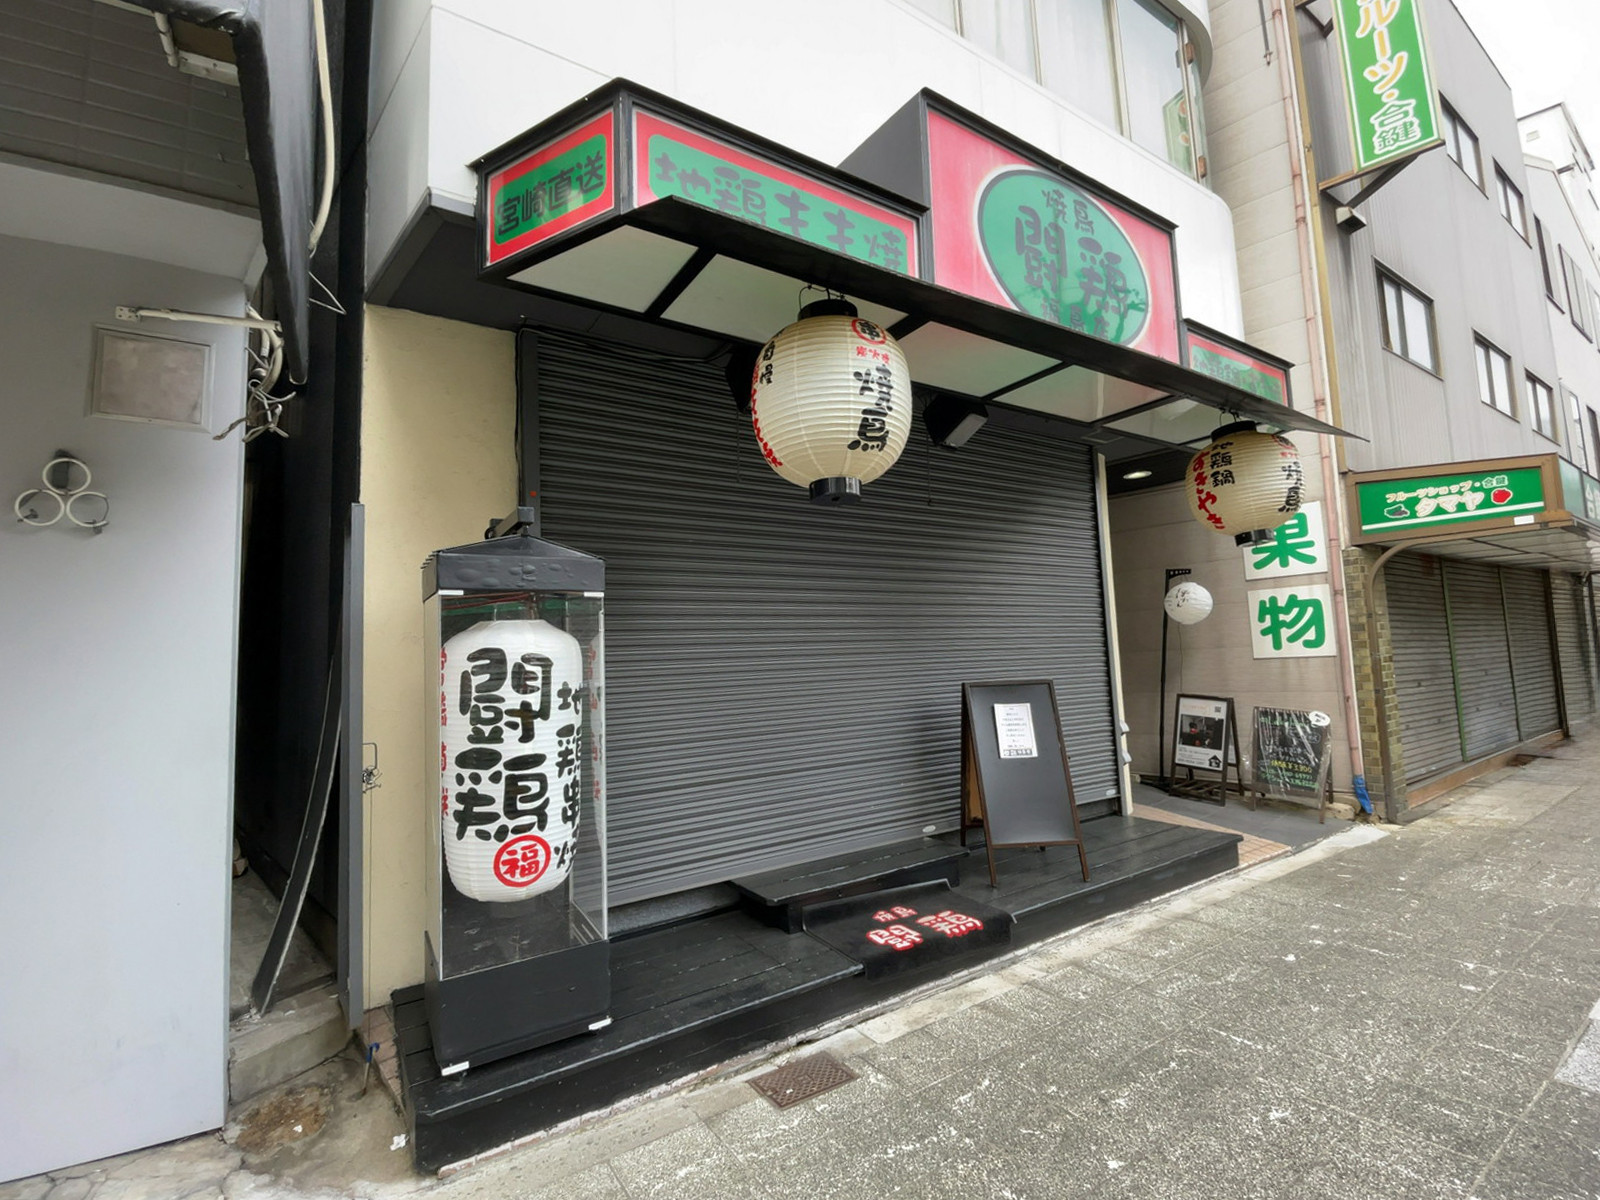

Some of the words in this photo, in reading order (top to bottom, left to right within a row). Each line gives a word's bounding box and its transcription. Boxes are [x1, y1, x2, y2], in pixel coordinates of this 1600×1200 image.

[1356, 0, 1421, 154] ルーツ・合鍵
[498, 152, 604, 236] 宮崎直送
[1041, 189, 1095, 236] 焼鳥
[1014, 204, 1131, 319] 闘鶏
[847, 364, 894, 453] 焼鳥
[1192, 450, 1227, 530] すきやき
[1414, 490, 1485, 518] タマヤ
[1257, 593, 1326, 651] 物
[453, 647, 554, 843] 闘鶏
[500, 843, 541, 879] 福
